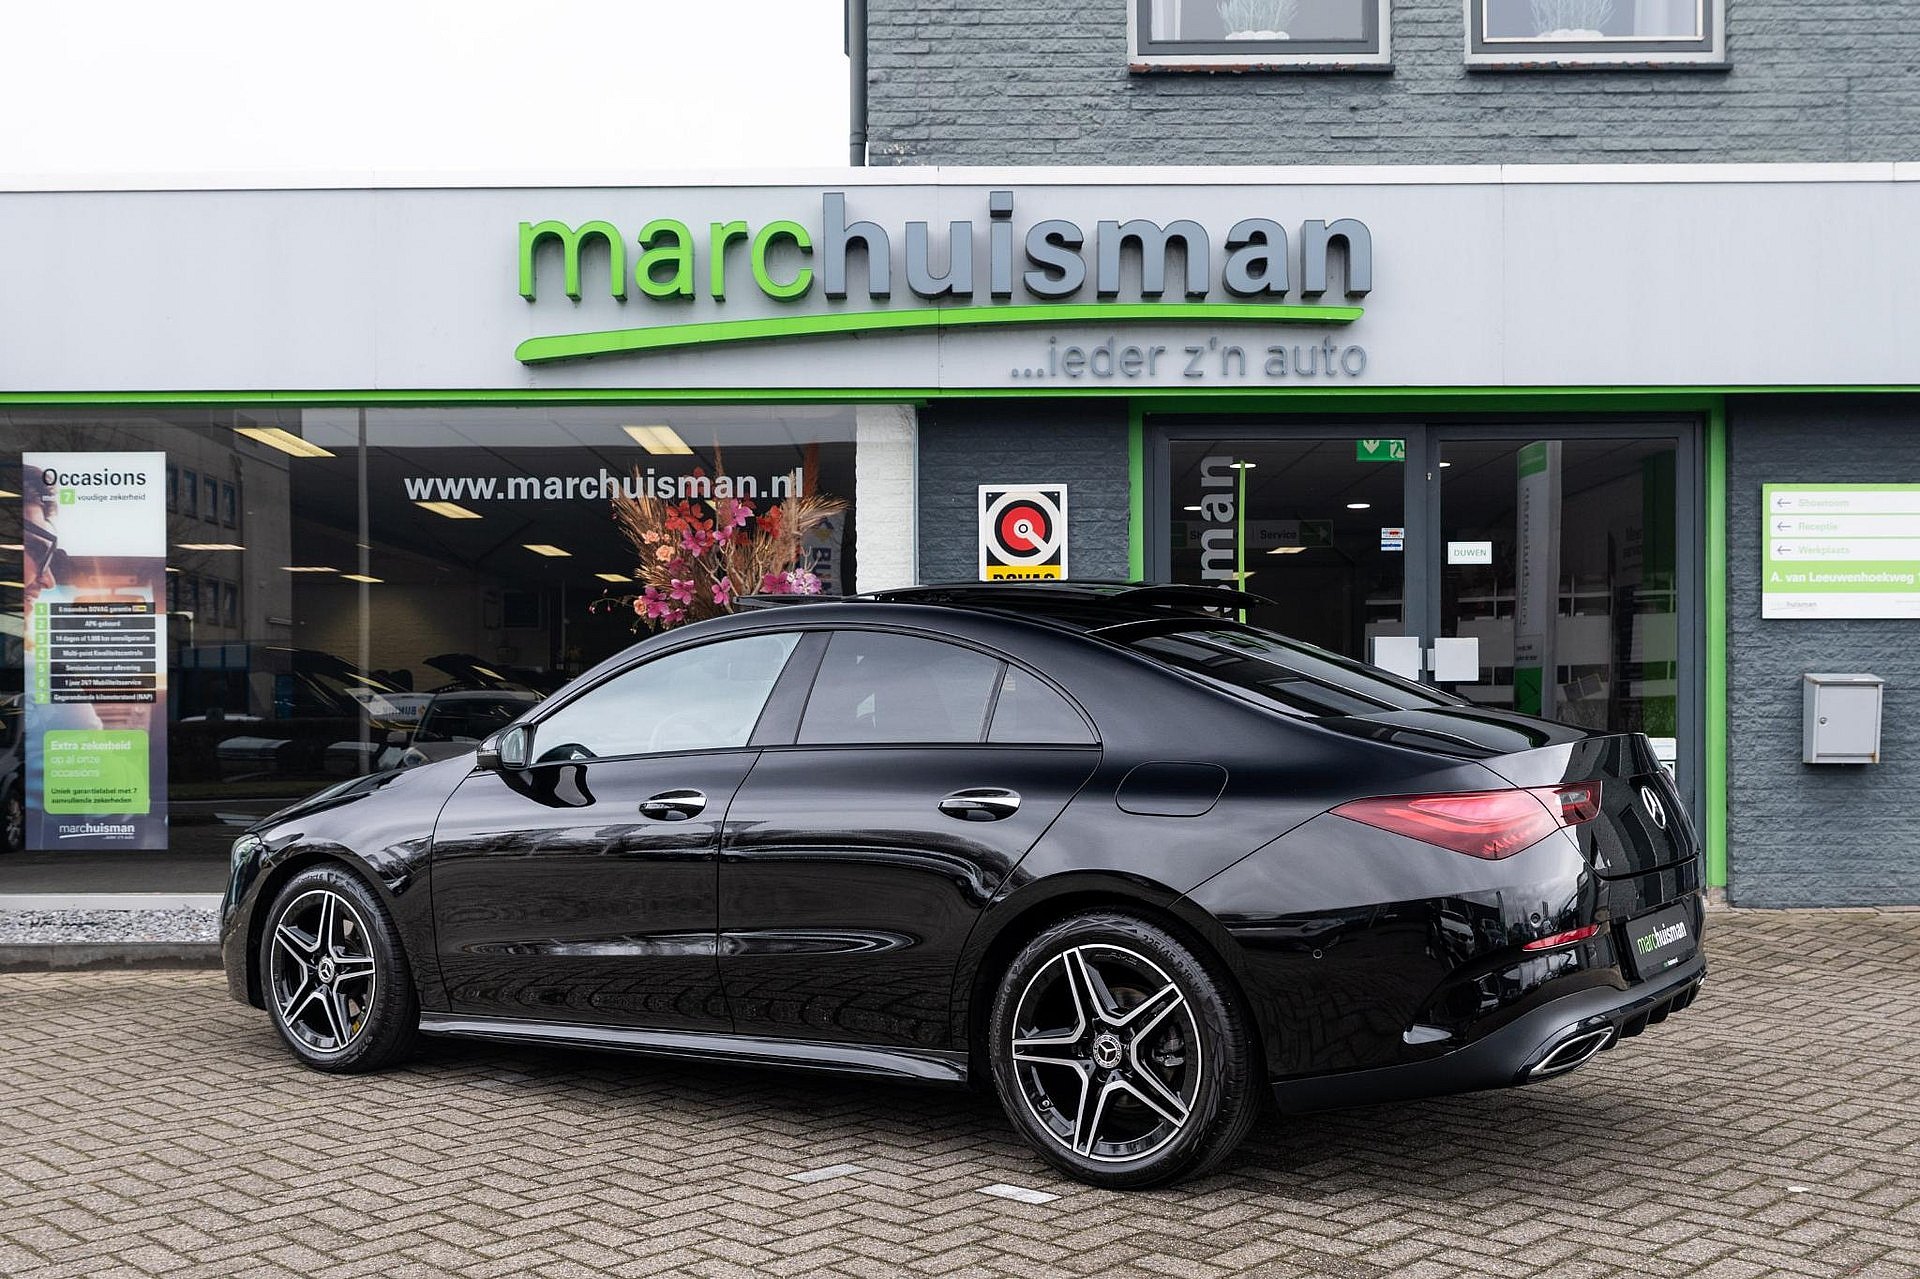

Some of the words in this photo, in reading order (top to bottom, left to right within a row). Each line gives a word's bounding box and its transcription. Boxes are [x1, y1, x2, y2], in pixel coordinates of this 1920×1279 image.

[518, 192, 1373, 303] marchuisman
[1011, 335, 1166, 378] ...ieder
[1184, 337, 1247, 377] z'n
[1264, 335, 1368, 377] auto
[42, 468, 147, 486] Occasions
[404, 467, 804, 500] www.marchuisman.nl
[77, 494, 108, 502] voudige
[109, 493, 146, 501] zekerheid
[1798, 522, 1838, 532] Receptie
[1259, 530, 1297, 540] Service
[1454, 549, 1487, 557] DUWEN
[1798, 545, 1850, 555] Werkplaats
[1771, 572, 1783, 582] A.
[1786, 574, 1806, 582] van
[1809, 572, 1914, 584] Leeuwenhoekweg
[51, 741, 78, 750] Extra
[80, 741, 131, 750] zekerheid
[59, 823, 135, 833] marchuisman
[1637, 921, 1687, 955] marchuisman
